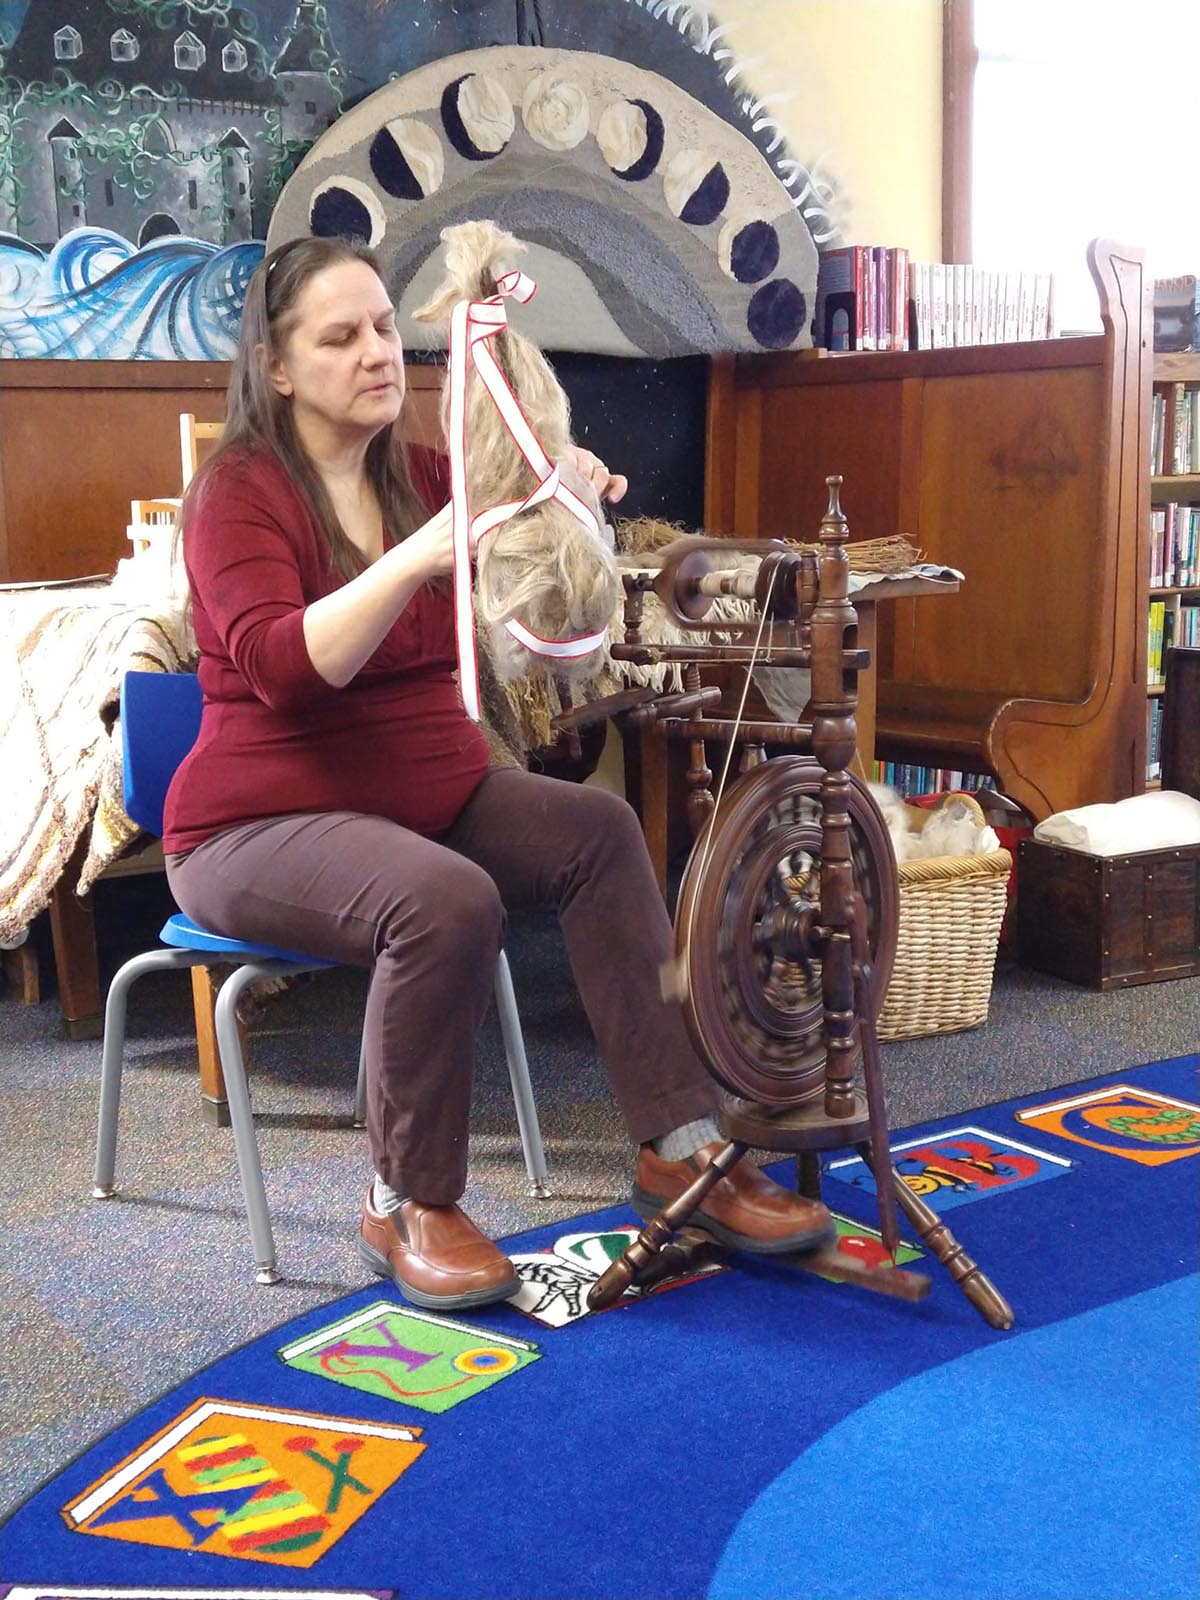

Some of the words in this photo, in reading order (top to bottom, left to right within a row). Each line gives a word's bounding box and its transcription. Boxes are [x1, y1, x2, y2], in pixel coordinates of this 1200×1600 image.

[1061, 1096, 1200, 1151] C
[893, 1141, 1039, 1191] B
[312, 1320, 443, 1373] Y
[88, 1468, 270, 1546] X
